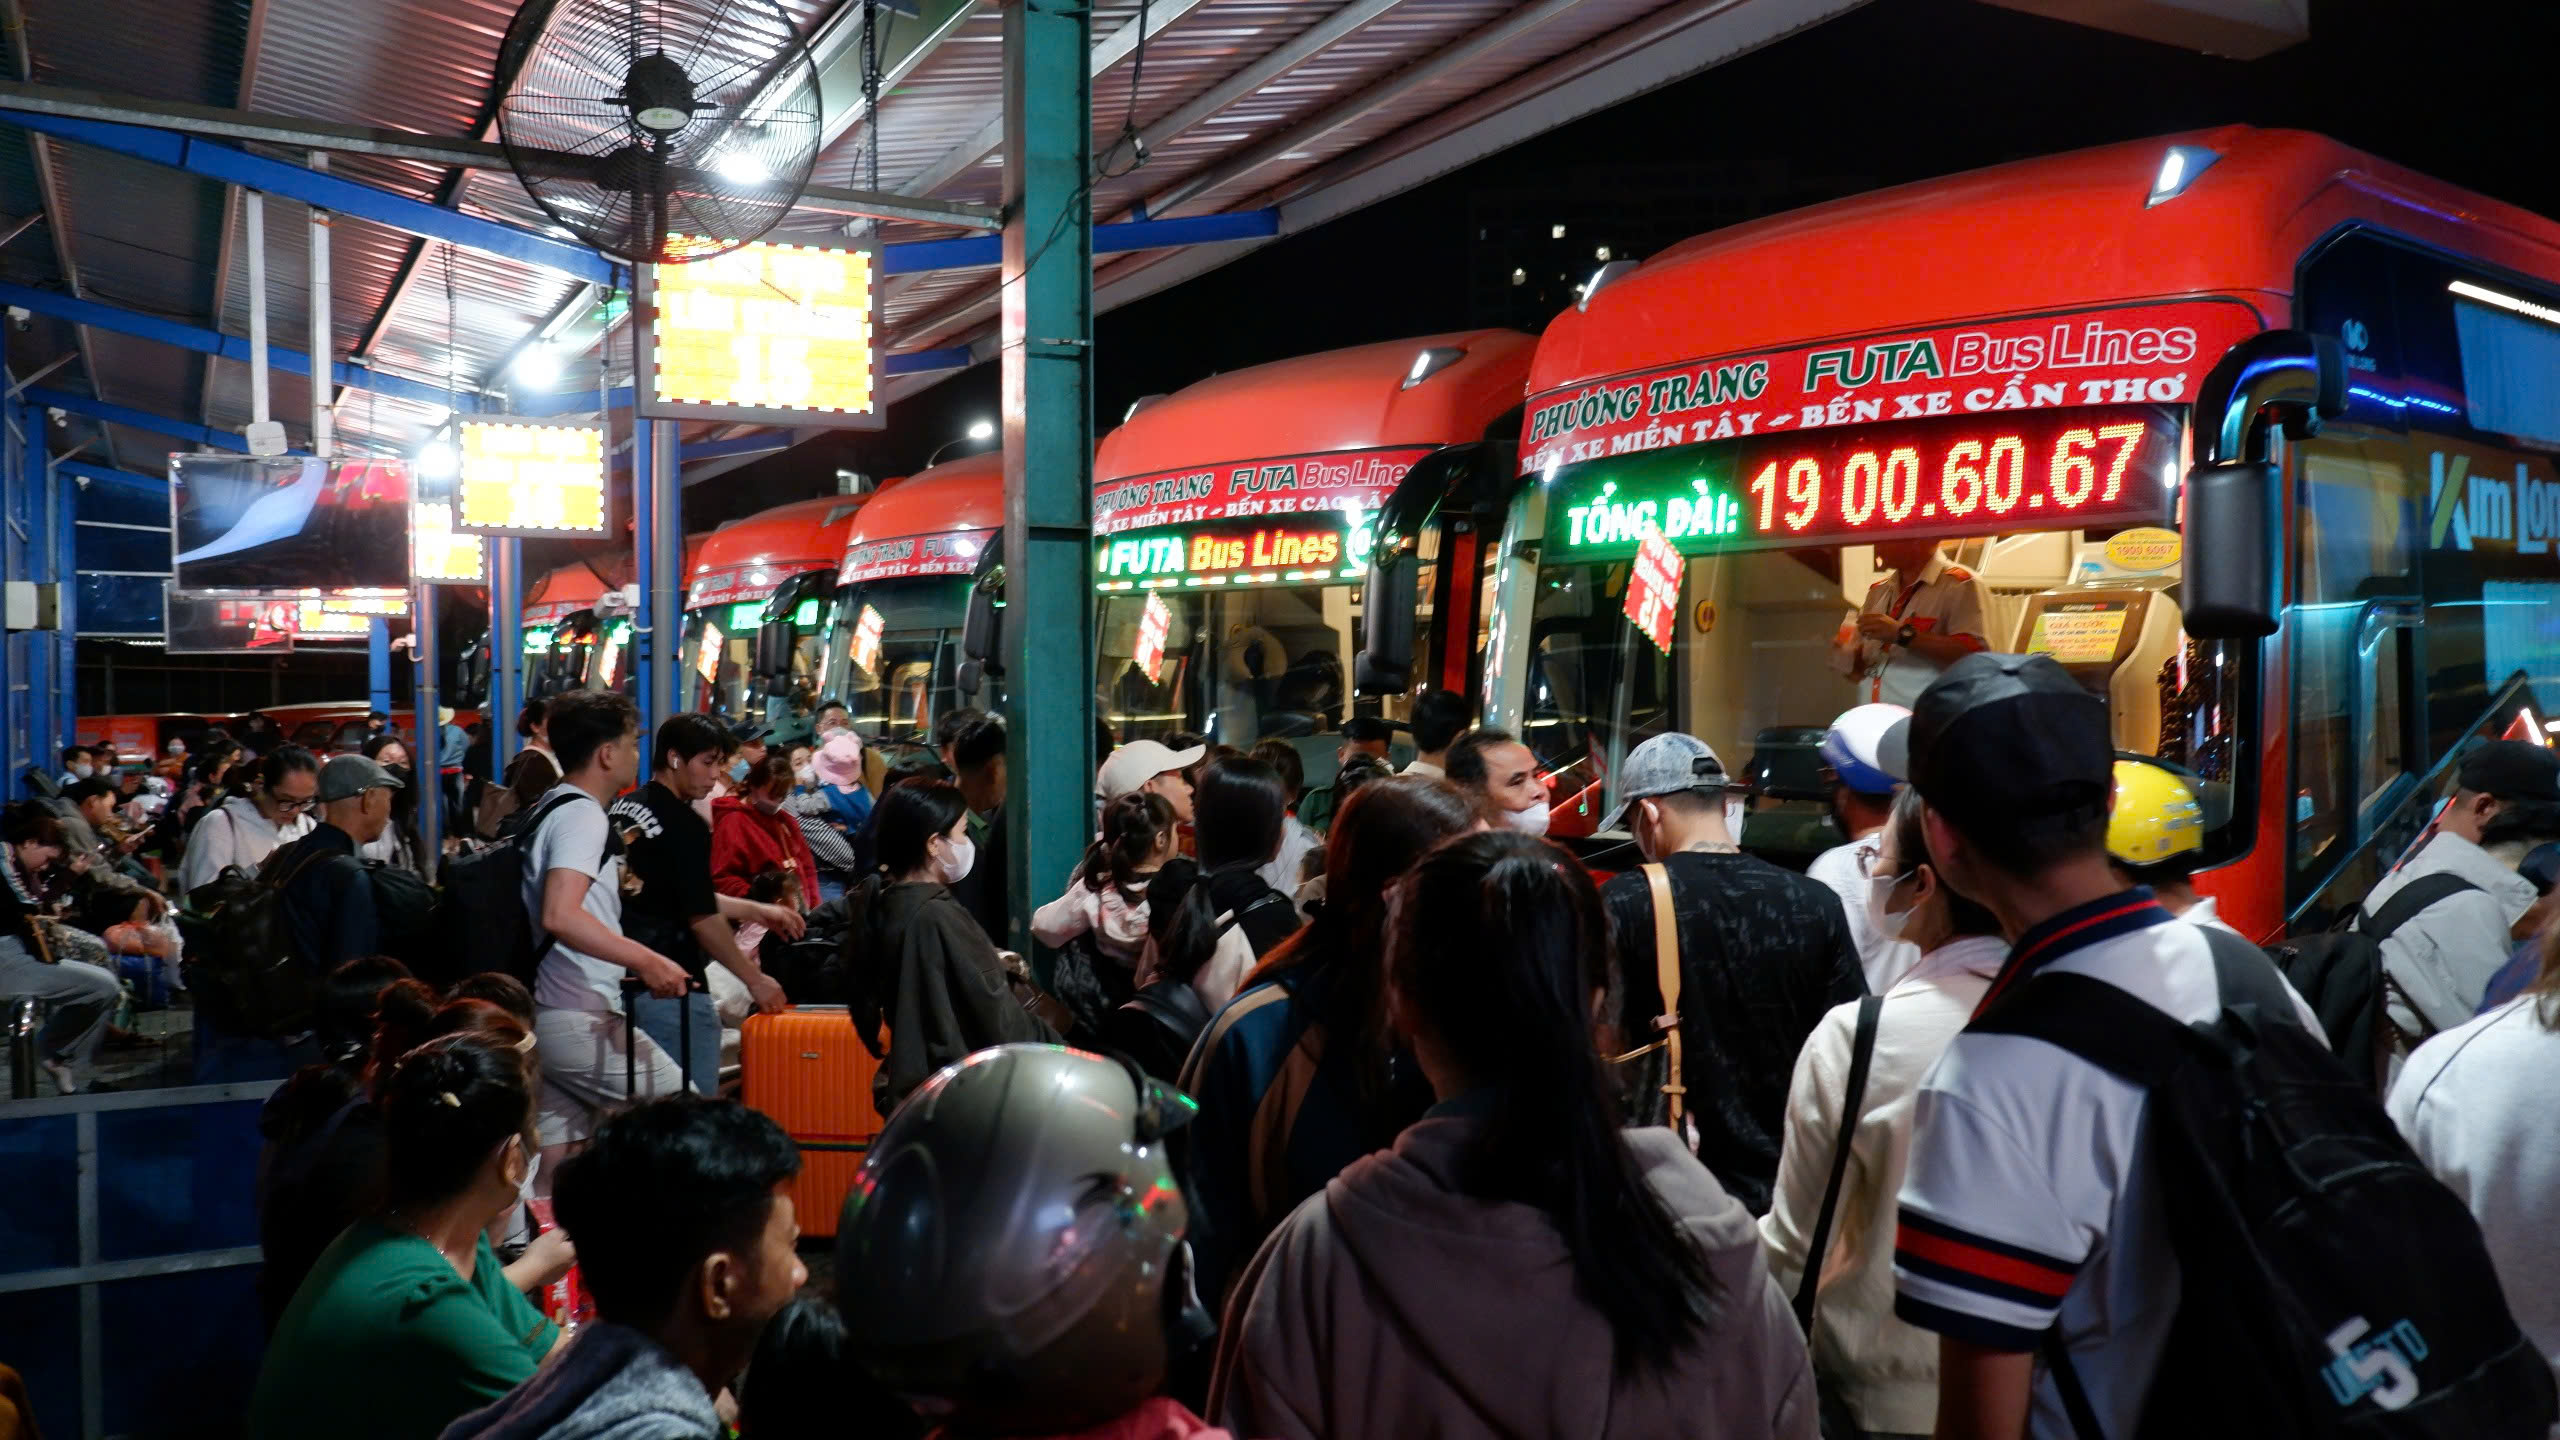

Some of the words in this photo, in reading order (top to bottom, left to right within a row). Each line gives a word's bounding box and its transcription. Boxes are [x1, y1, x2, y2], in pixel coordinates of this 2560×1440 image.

[1528, 384, 1642, 444] PHƯƠNG
[1648, 360, 1769, 417] TRANG
[1803, 336, 1942, 393] FUTA
[1950, 331, 2045, 377] Bus
[2048, 321, 2198, 369] Lines
[1569, 438, 1605, 463] XE
[1610, 418, 1685, 456] MIỀN
[1692, 410, 1762, 440] TÂY
[1800, 390, 1882, 428] BẾN
[1890, 390, 1952, 418] XE
[1963, 372, 2066, 409] CẦN
[2078, 374, 2187, 404] THƠ
[1111, 517, 1129, 532] XE
[1131, 506, 1170, 528] MIỀN
[1172, 504, 1208, 522] TÂY
[1224, 495, 1265, 517] BẾN
[1267, 497, 1297, 513] XE
[1151, 472, 1215, 506] TRANG
[1228, 464, 1298, 496] FUTA
[1301, 461, 1349, 489] Bus
[1349, 458, 1412, 487] Line
[1568, 481, 1658, 545] TỔNG
[1664, 479, 1739, 537] ĐÀI:
[2430, 450, 2512, 550] Kim
[2515, 462, 2560, 558] Lon
[1110, 536, 1184, 576] FUTA
[1189, 535, 1245, 571] Bus
[1250, 529, 1338, 568] Lines
